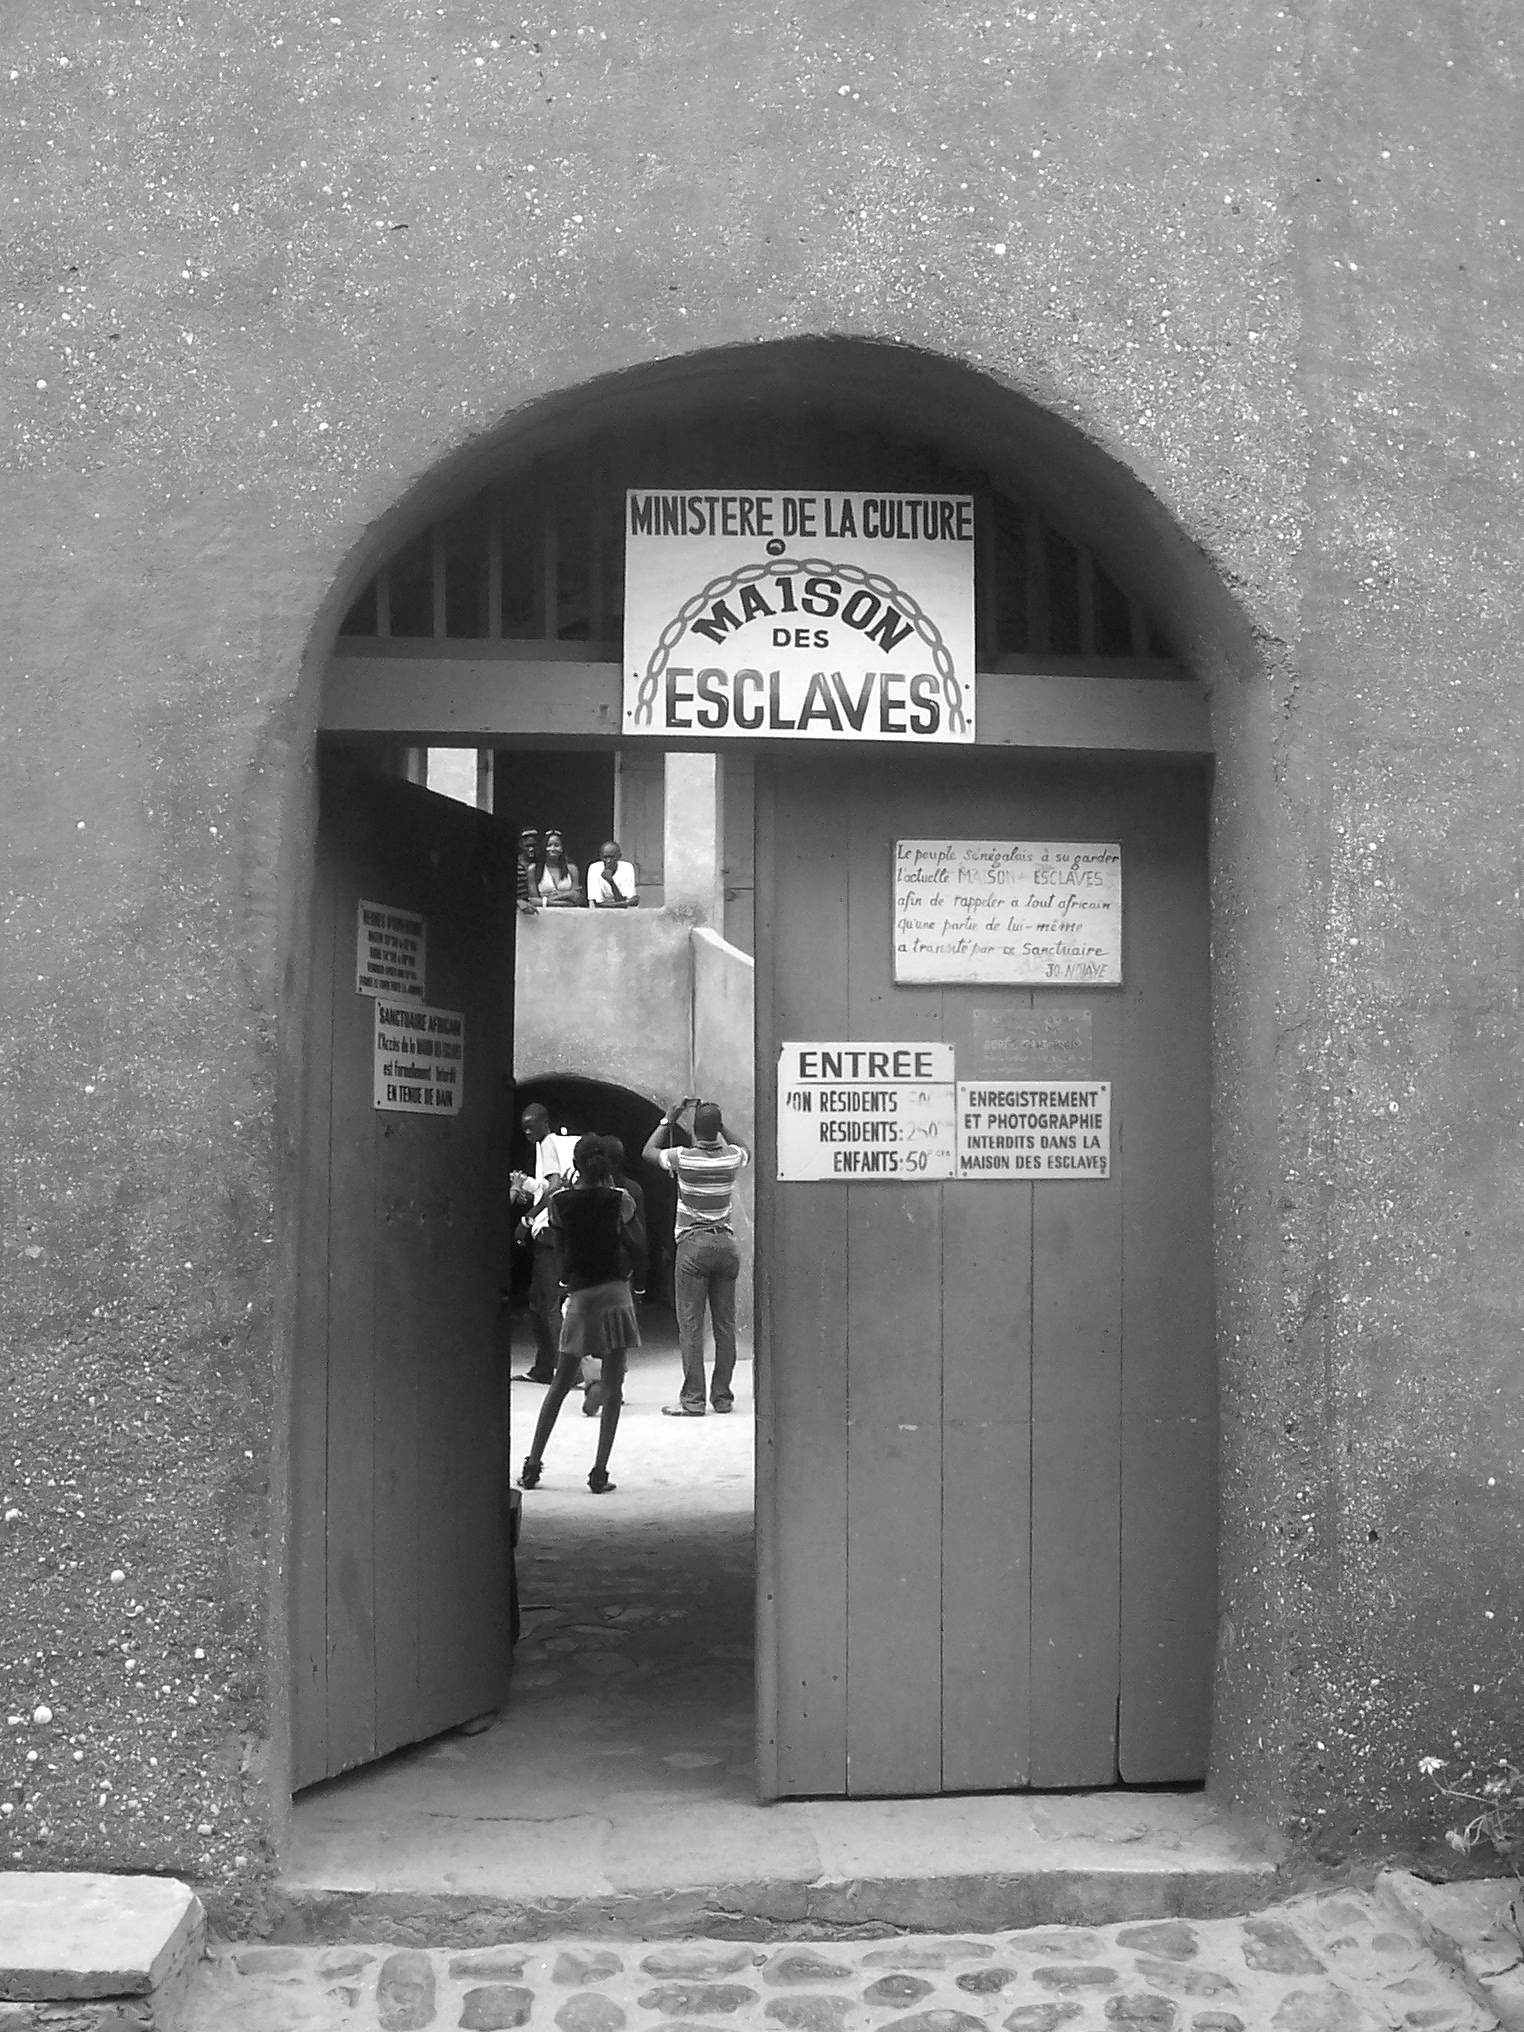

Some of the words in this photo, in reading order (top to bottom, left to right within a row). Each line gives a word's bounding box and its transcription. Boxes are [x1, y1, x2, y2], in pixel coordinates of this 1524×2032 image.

[630, 495, 774, 536] MINISTERE
[783, 497, 817, 537] DE
[825, 498, 857, 538] LA
[863, 500, 973, 541] CULTURE
[772, 628, 829, 648] DES
[665, 668, 940, 735] ESCLAVES
[897, 844, 910, 860] Le
[915, 845, 957, 867] peuple
[1056, 853, 1070, 863] su
[1074, 849, 1120, 870] garder
[958, 868, 1015, 885] MASON
[1034, 870, 1103, 887] ESCLAVES
[897, 890, 922, 912] afin
[930, 892, 945, 906] de
[954, 892, 1005, 912] rappeler
[1025, 893, 1053, 908] tout
[1058, 894, 1112, 915] africain
[942, 915, 978, 936] partie
[985, 916, 1001, 931] de
[897, 944, 907, 952] a
[970, 941, 995, 959] par
[1023, 940, 1109, 956] Sanctuaire
[969, 1091, 1098, 1107] ENREGISTREMENT
[964, 1113, 981, 1129] ET
[988, 1113, 1103, 1129] PHOTOGRAPHIE
[967, 1135, 1035, 1149] INTERDITS
[1040, 1135, 1077, 1149] DANS
[1083, 1135, 1101, 1149] LA
[960, 1155, 1009, 1169] MAISON
[1015, 1155, 1041, 1169] DES
[1047, 1155, 1107, 1169] ESCLAVES
